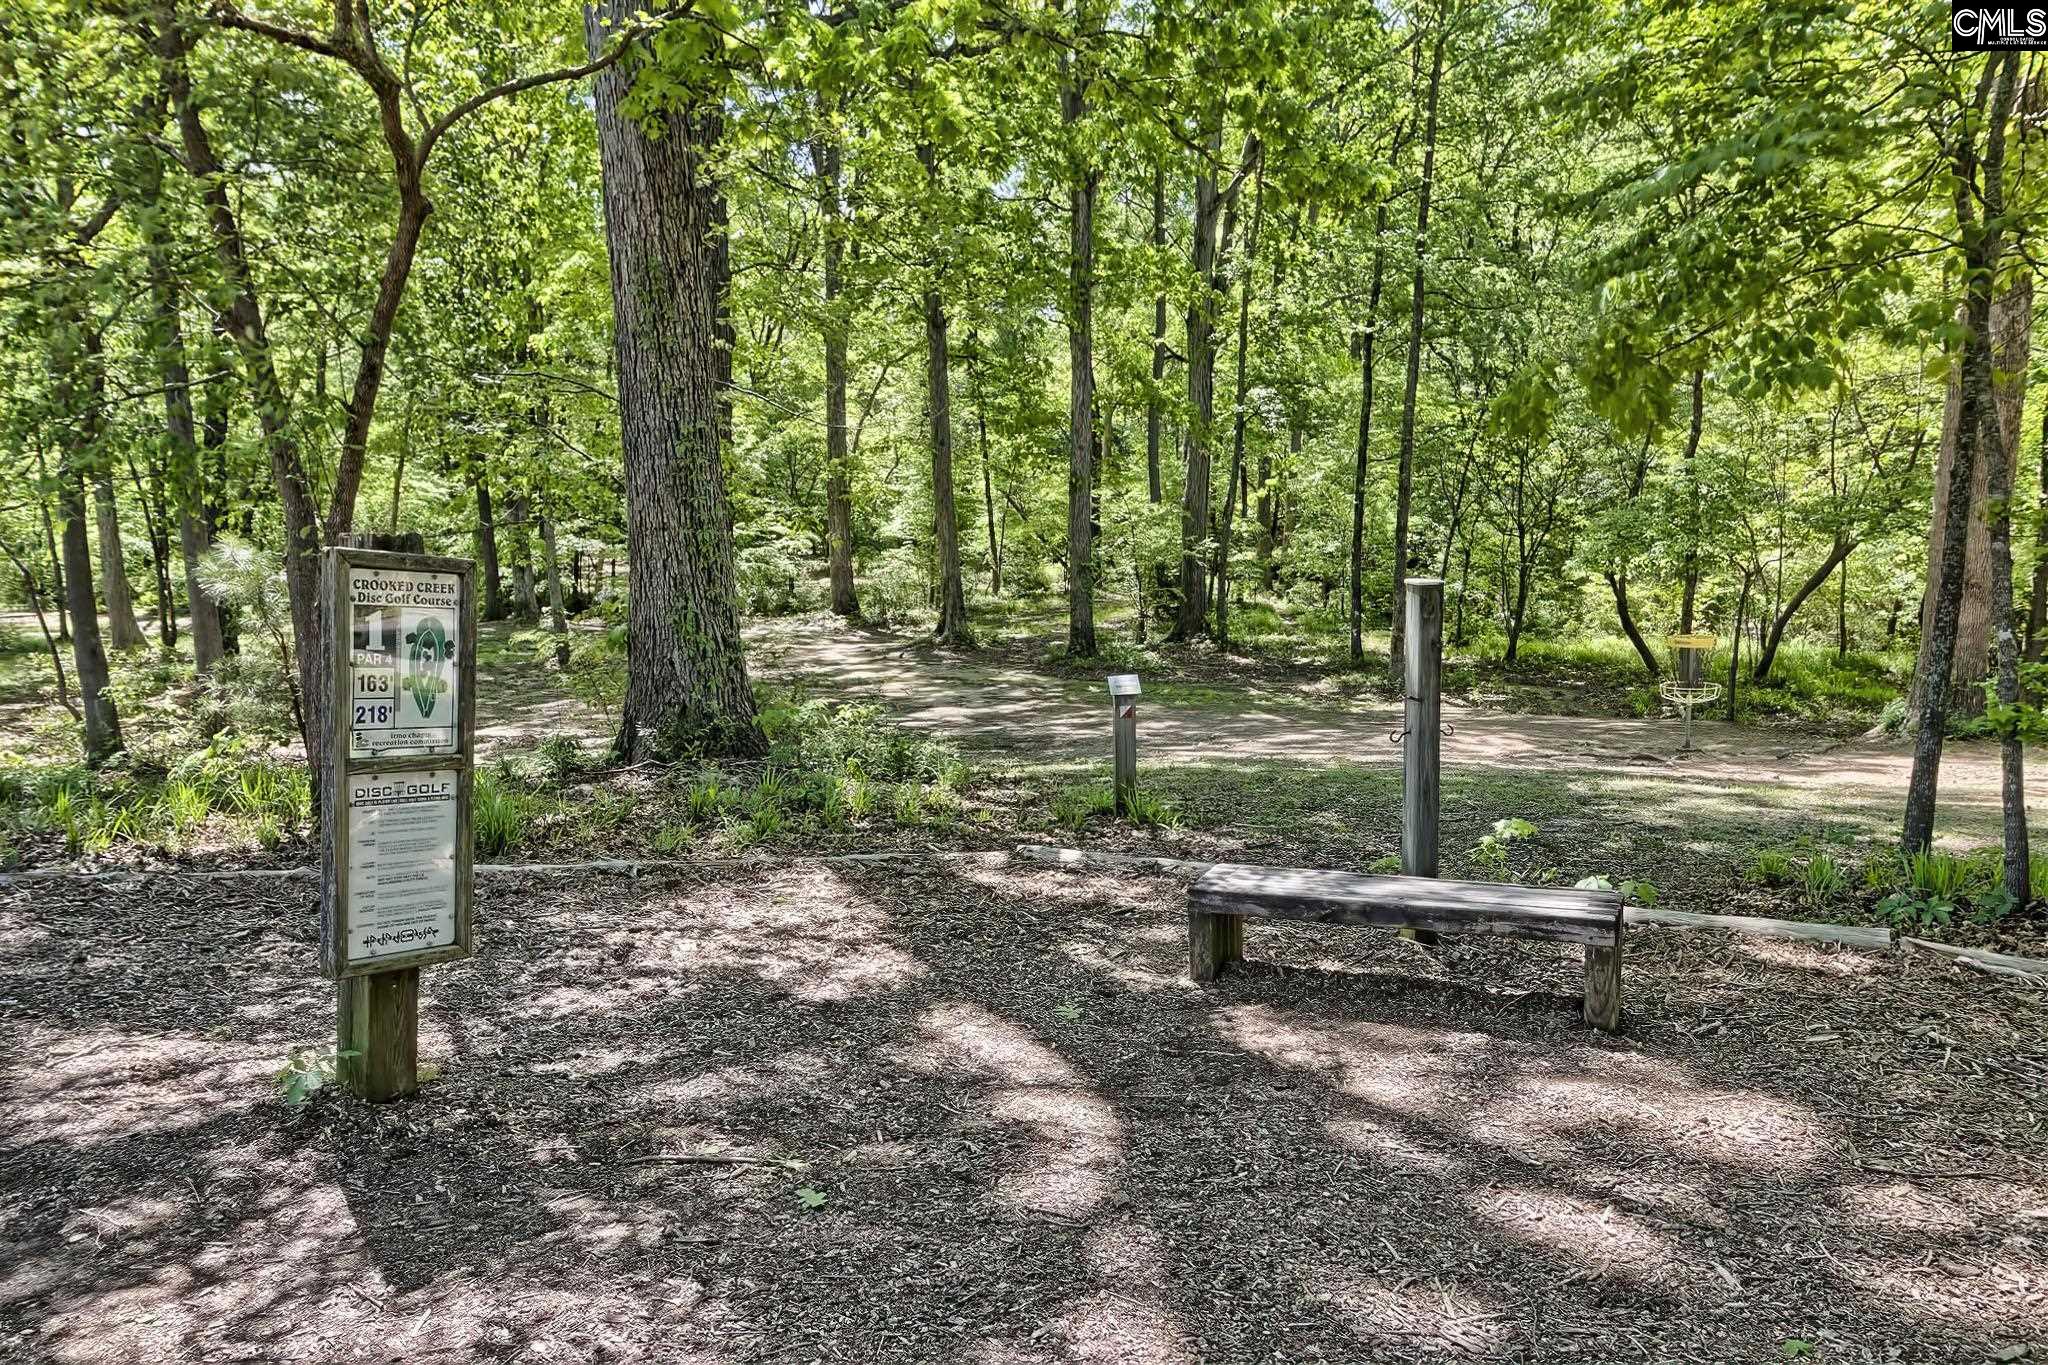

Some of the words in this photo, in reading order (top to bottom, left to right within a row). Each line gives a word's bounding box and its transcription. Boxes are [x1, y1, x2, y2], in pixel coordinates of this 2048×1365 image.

[353, 579, 414, 592] CROOKED
[416, 583, 455, 594] CREEK
[357, 592, 382, 603] Disc
[385, 593, 411, 604] Golf
[413, 594, 452, 606] Course
[364, 610, 386, 651] 1
[357, 653, 382, 665] PAR
[385, 654, 393, 665] 4
[357, 674, 393, 692] 163'
[355, 705, 393, 724] 218'
[355, 786, 392, 799] DISC
[406, 782, 450, 795] GOLF
